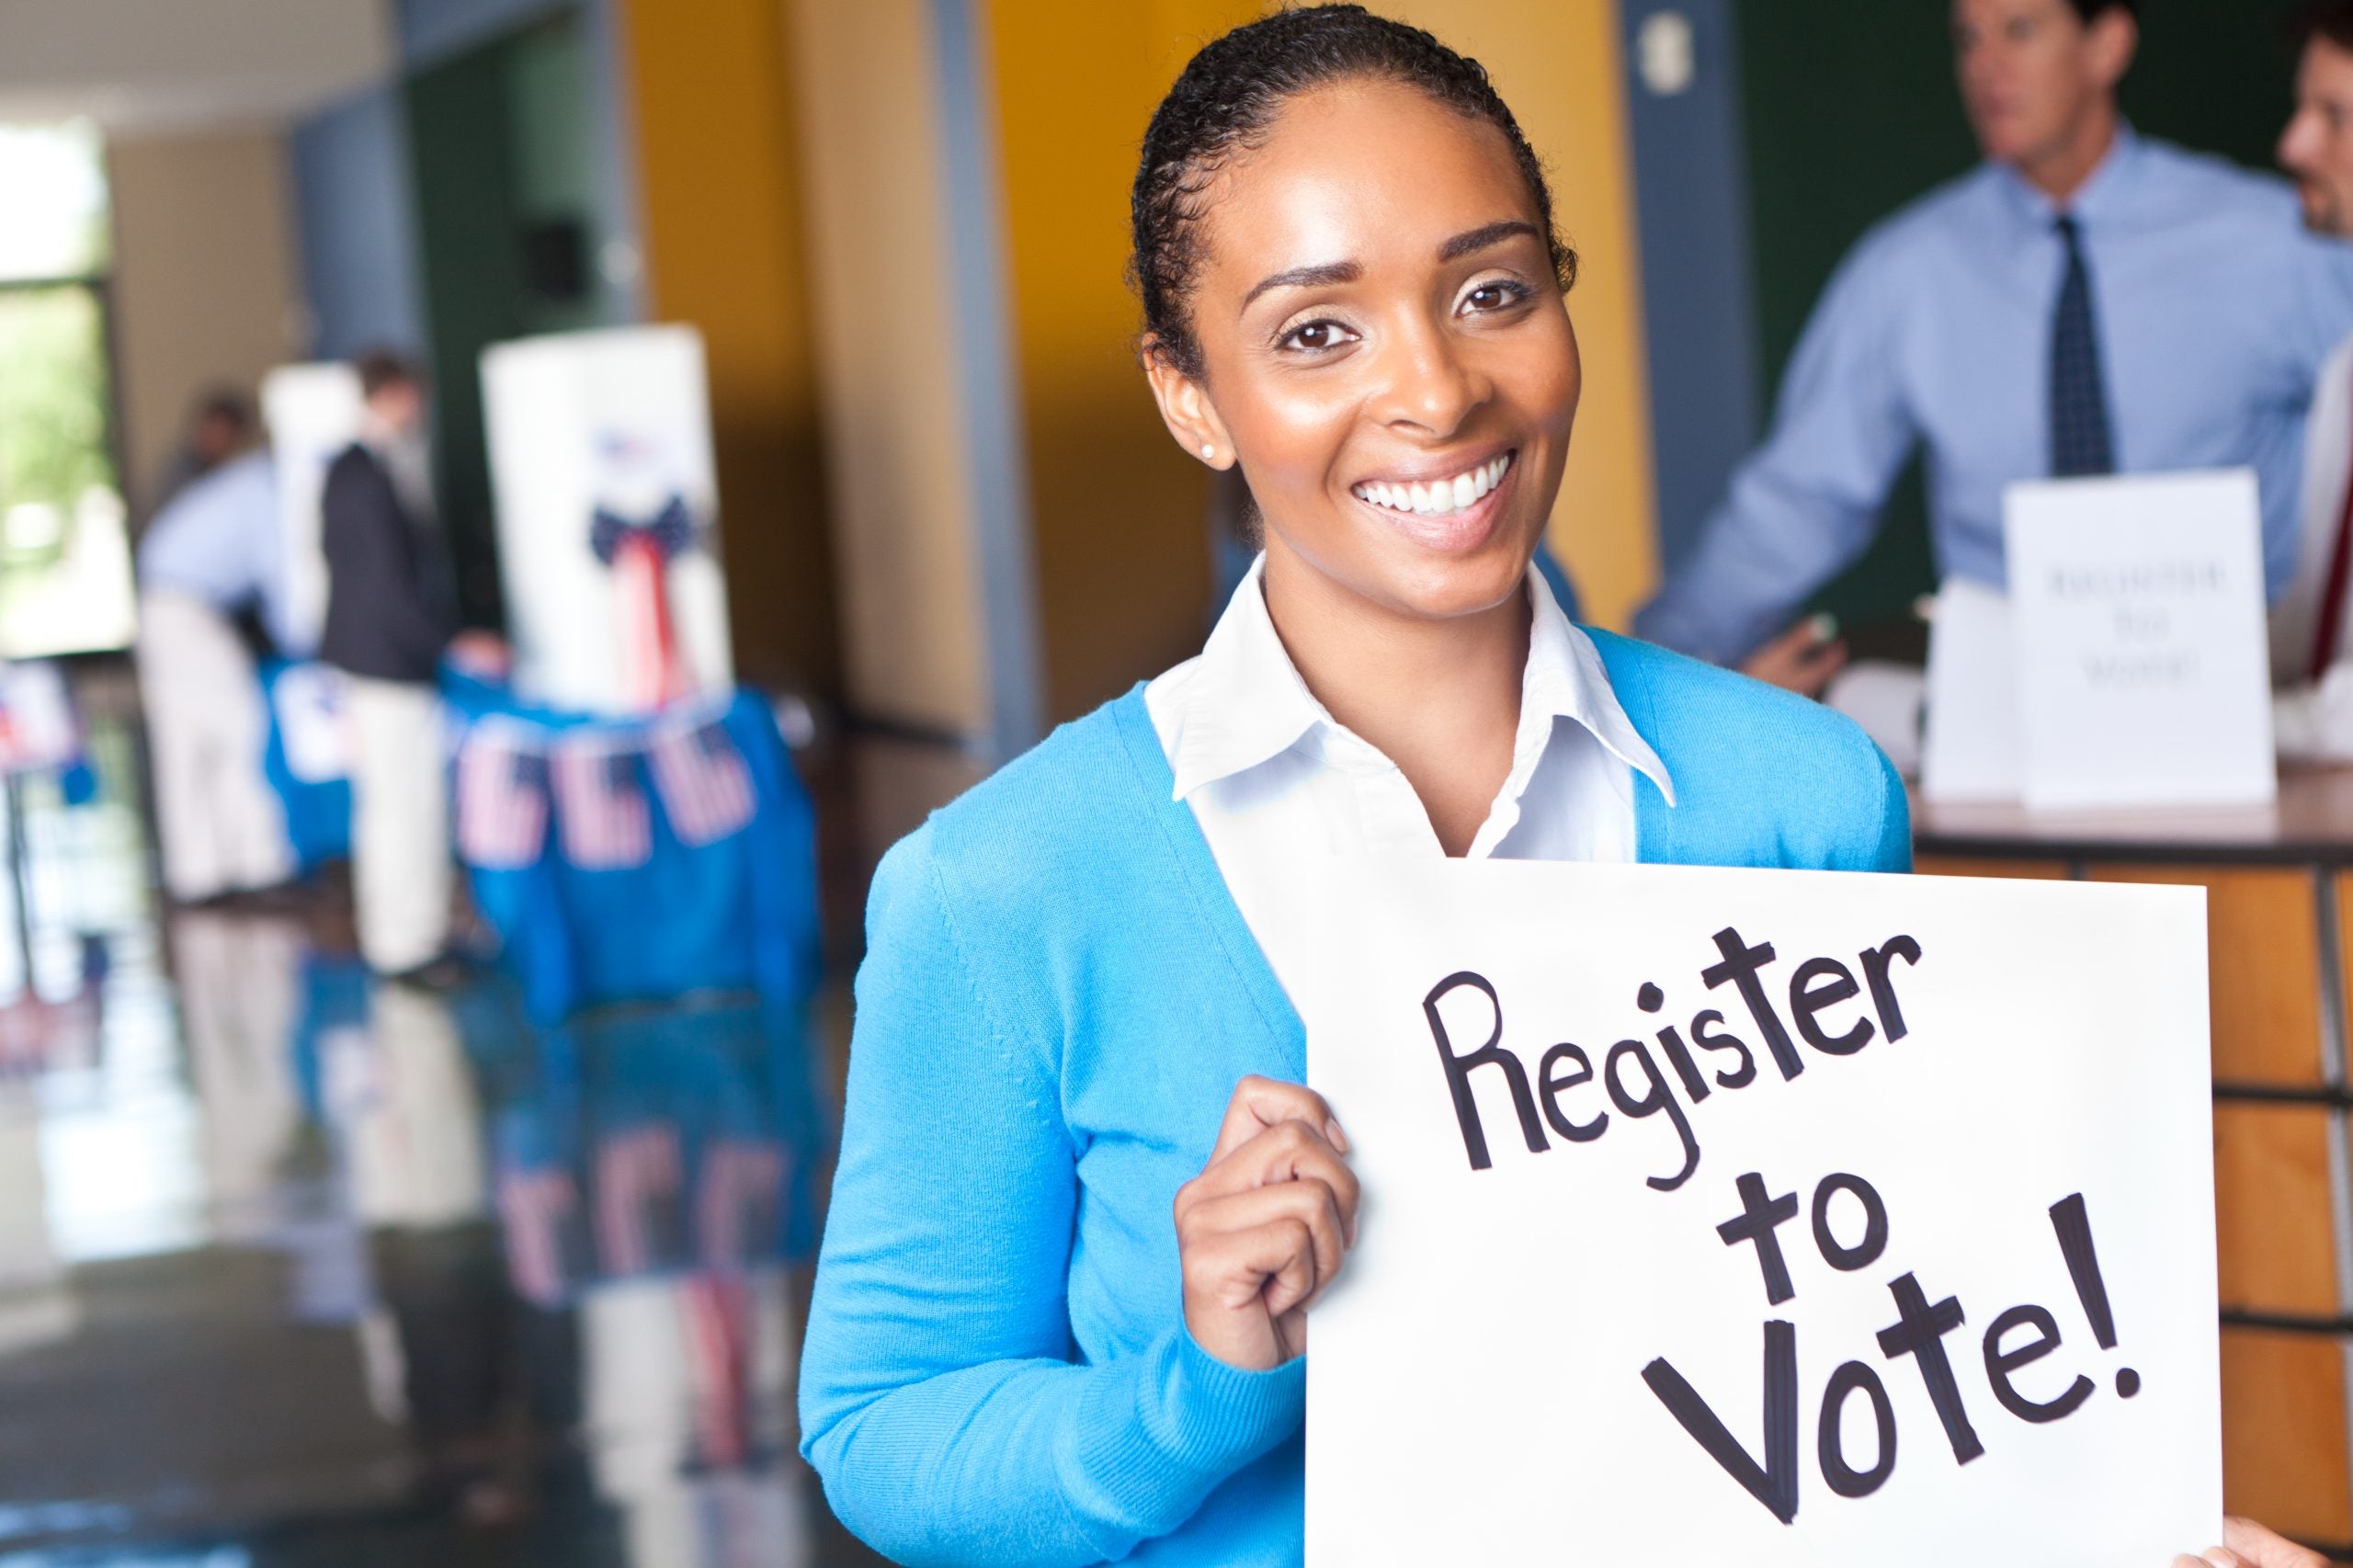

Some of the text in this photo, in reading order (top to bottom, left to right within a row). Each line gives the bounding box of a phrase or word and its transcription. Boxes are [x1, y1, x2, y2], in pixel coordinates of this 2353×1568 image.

[1422, 926, 1922, 1192] Register
[1641, 1192, 2141, 1525] Vote!
[1716, 1172, 1889, 1306] to
